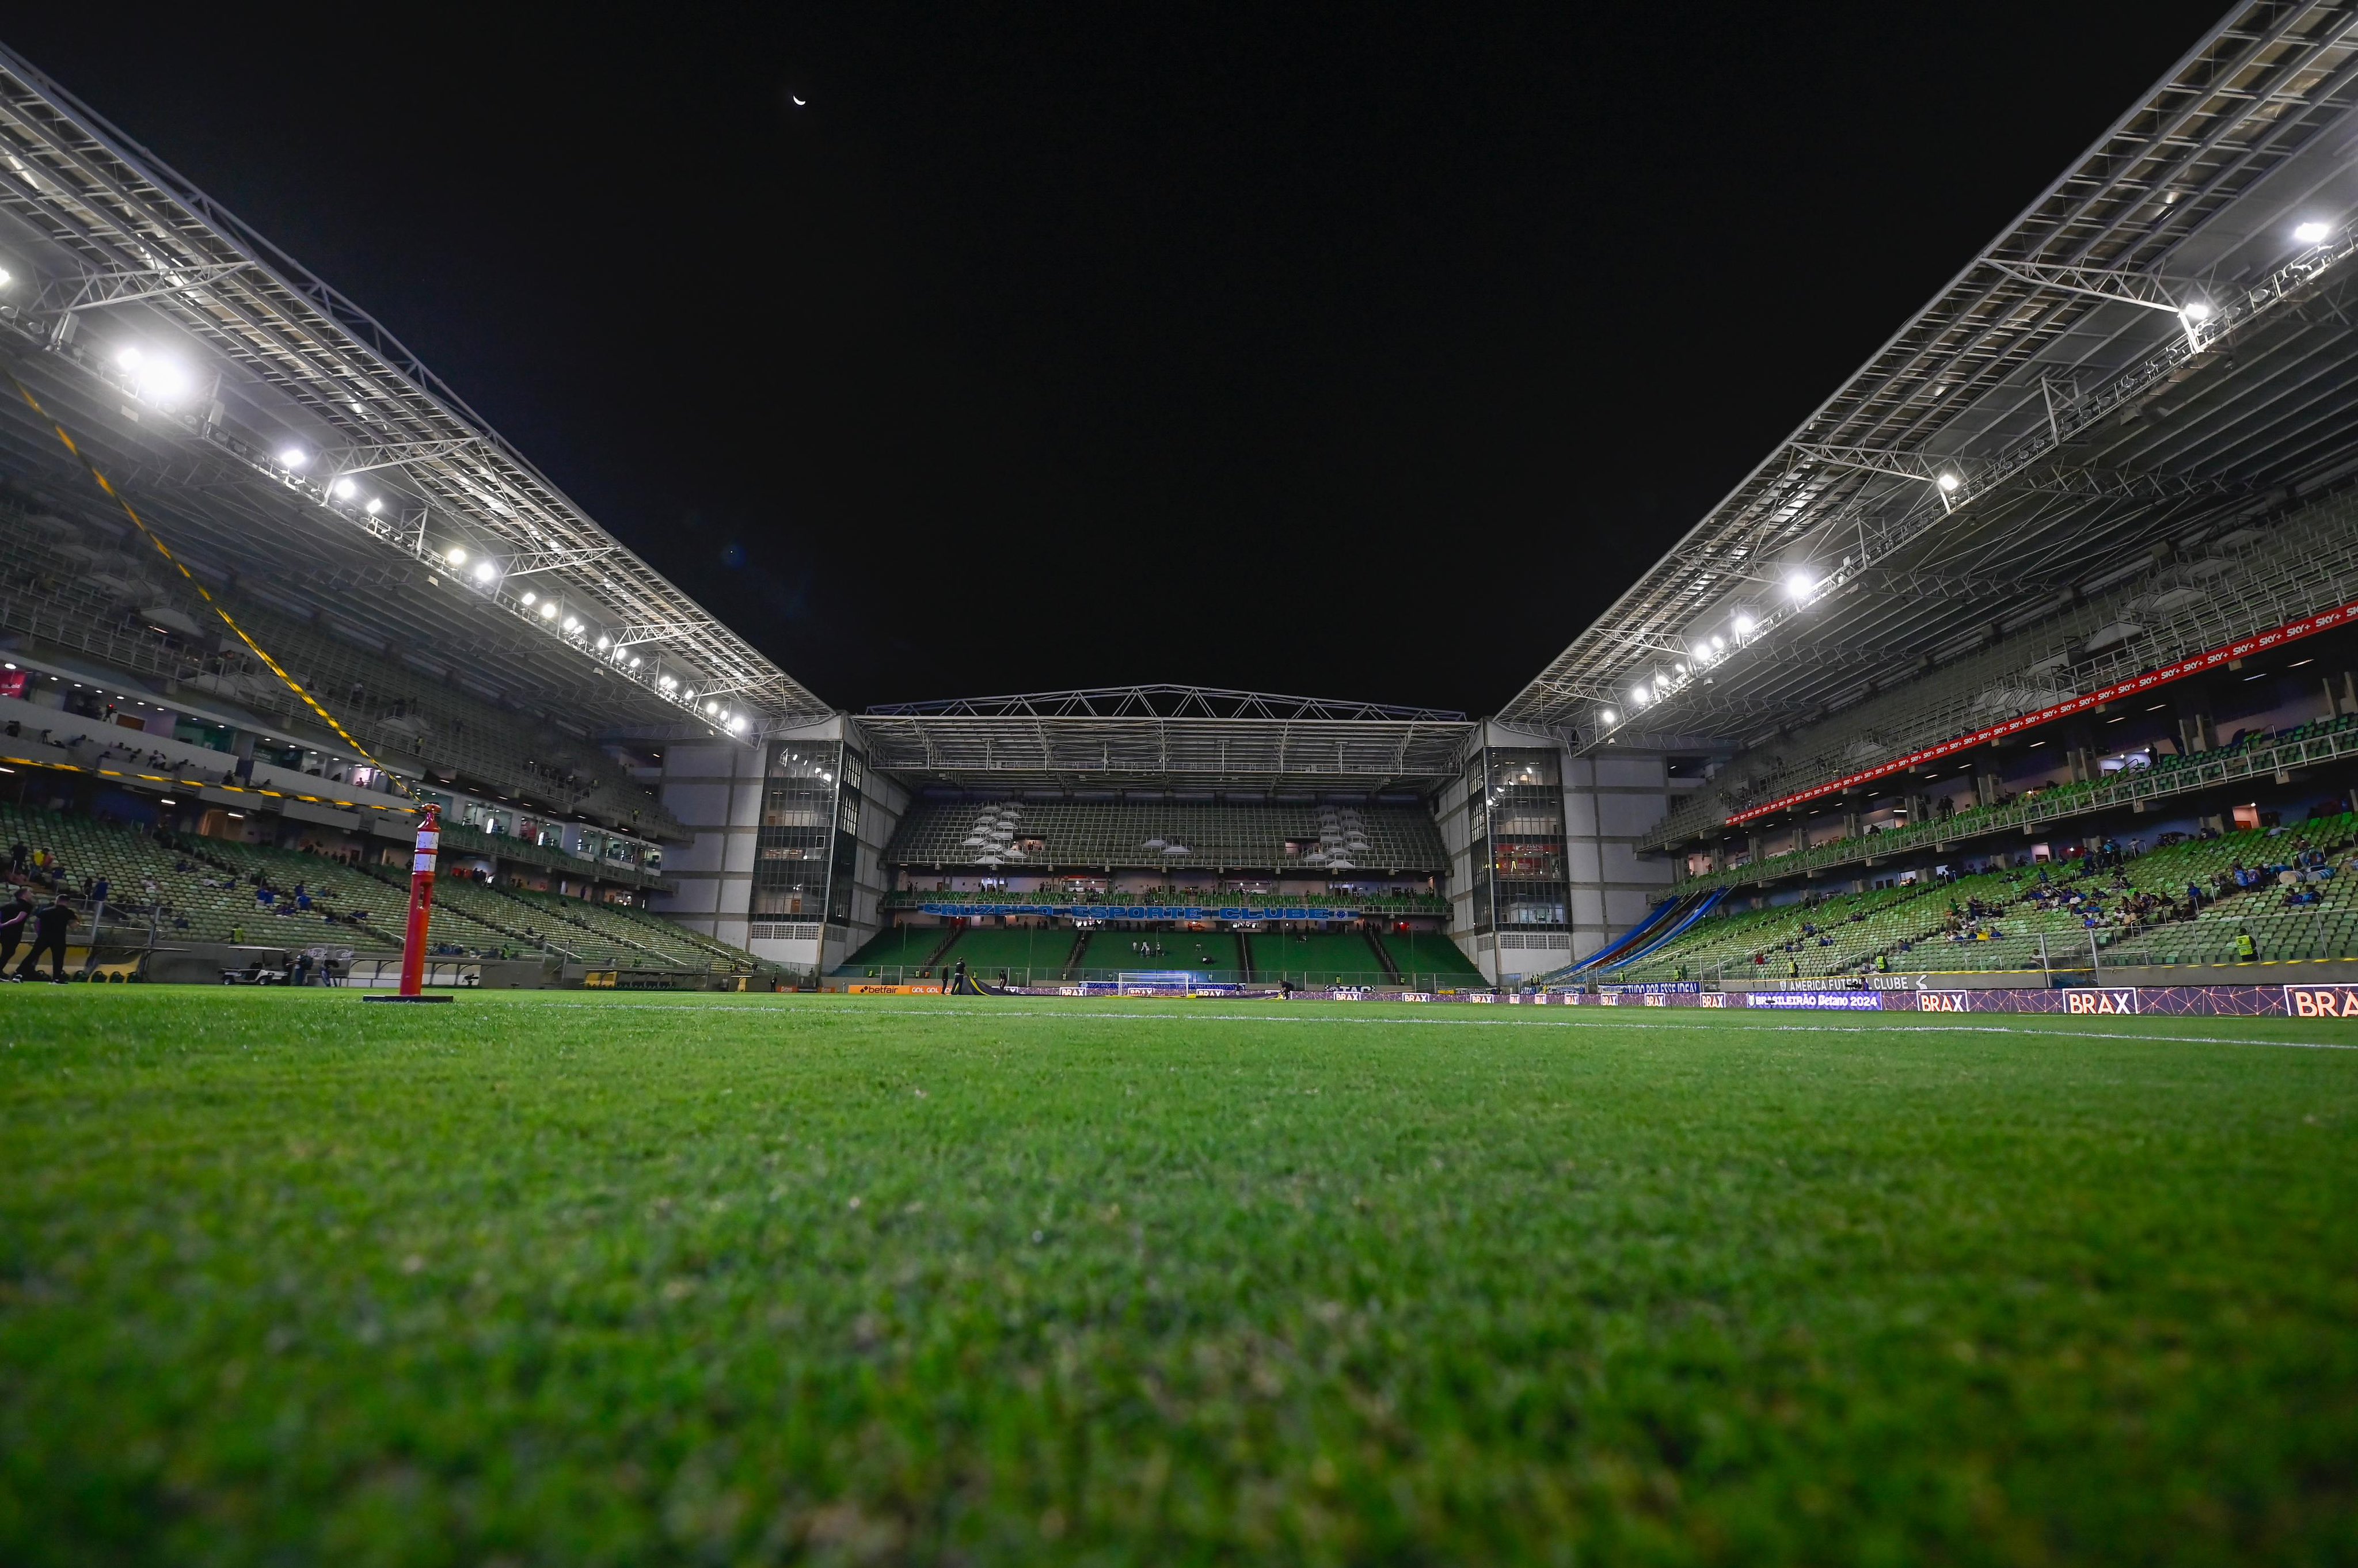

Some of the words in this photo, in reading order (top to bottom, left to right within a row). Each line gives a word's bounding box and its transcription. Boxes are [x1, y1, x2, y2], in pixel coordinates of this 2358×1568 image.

[1978, 732, 1992, 740] SKY+
[1994, 726, 2007, 735] SKY+
[2009, 721, 2024, 730] SKY+
[2025, 716, 2040, 725] SKY+
[2042, 709, 2057, 719] SKY+
[2060, 703, 2076, 713] SKY+
[2079, 697, 2095, 707] SKY+
[2098, 690, 2115, 701] SKY+
[2118, 683, 2136, 694] SKY+
[2139, 676, 2158, 687] SKY+
[2161, 668, 2181, 679] SKY+
[2183, 660, 2204, 672] SKY+
[2207, 652, 2228, 664] SKY+
[2233, 642, 2255, 656] SKY+
[2259, 633, 2282, 646] SKY+
[2287, 624, 2311, 637] SKY+
[2315, 614, 2341, 627] SKY+
[1071, 905, 1202, 919] ESPORTE
[1219, 907, 1329, 920] CLUBE
[869, 985, 898, 994] betfair
[1874, 976, 1908, 990] CLUBE
[1336, 993, 1359, 1001] BRAX
[1404, 994, 1427, 1002] BRAX
[1602, 995, 1617, 1006] BRAX
[1646, 995, 1664, 1007] BRAX
[1702, 995, 1724, 1008] BRAX
[1755, 993, 1817, 1006] BRASILEIRÃO
[1818, 995, 1848, 1006] Betano
[1850, 996, 1877, 1007] 2024
[1921, 994, 1964, 1012] BRAX
[2069, 992, 2131, 1014] BRAX
